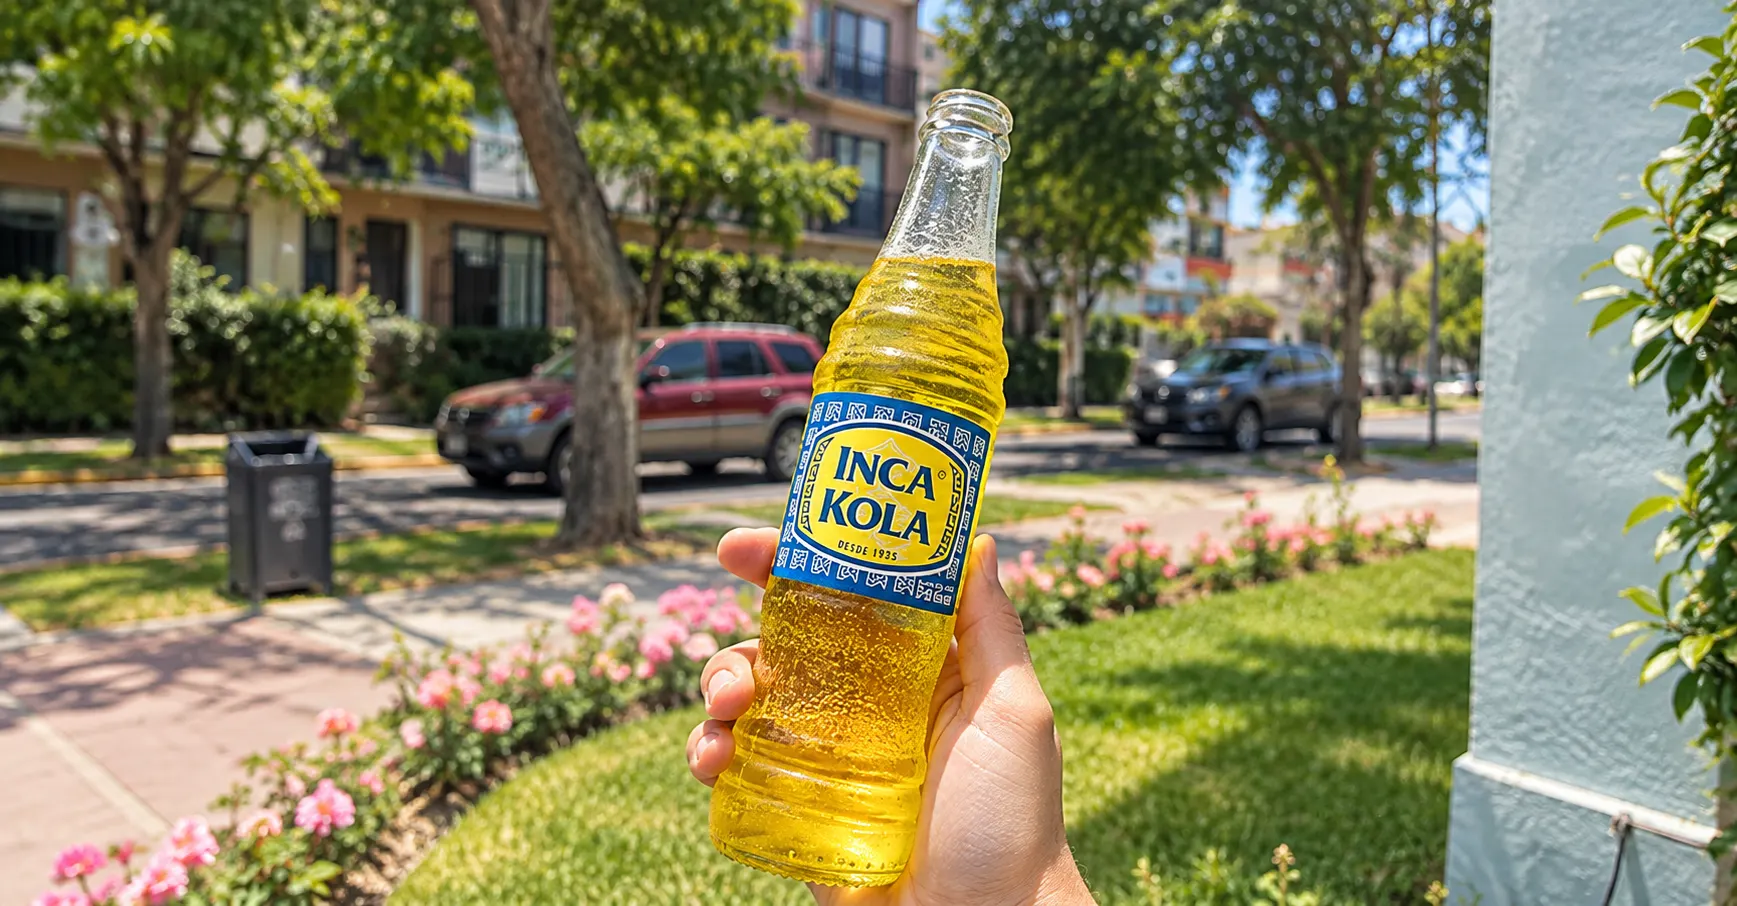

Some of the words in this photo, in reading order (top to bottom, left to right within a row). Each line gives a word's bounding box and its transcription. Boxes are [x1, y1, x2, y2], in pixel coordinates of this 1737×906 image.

[834, 446, 935, 501] INCA
[818, 489, 930, 546] KOLA
[838, 540, 868, 556] DESDE
